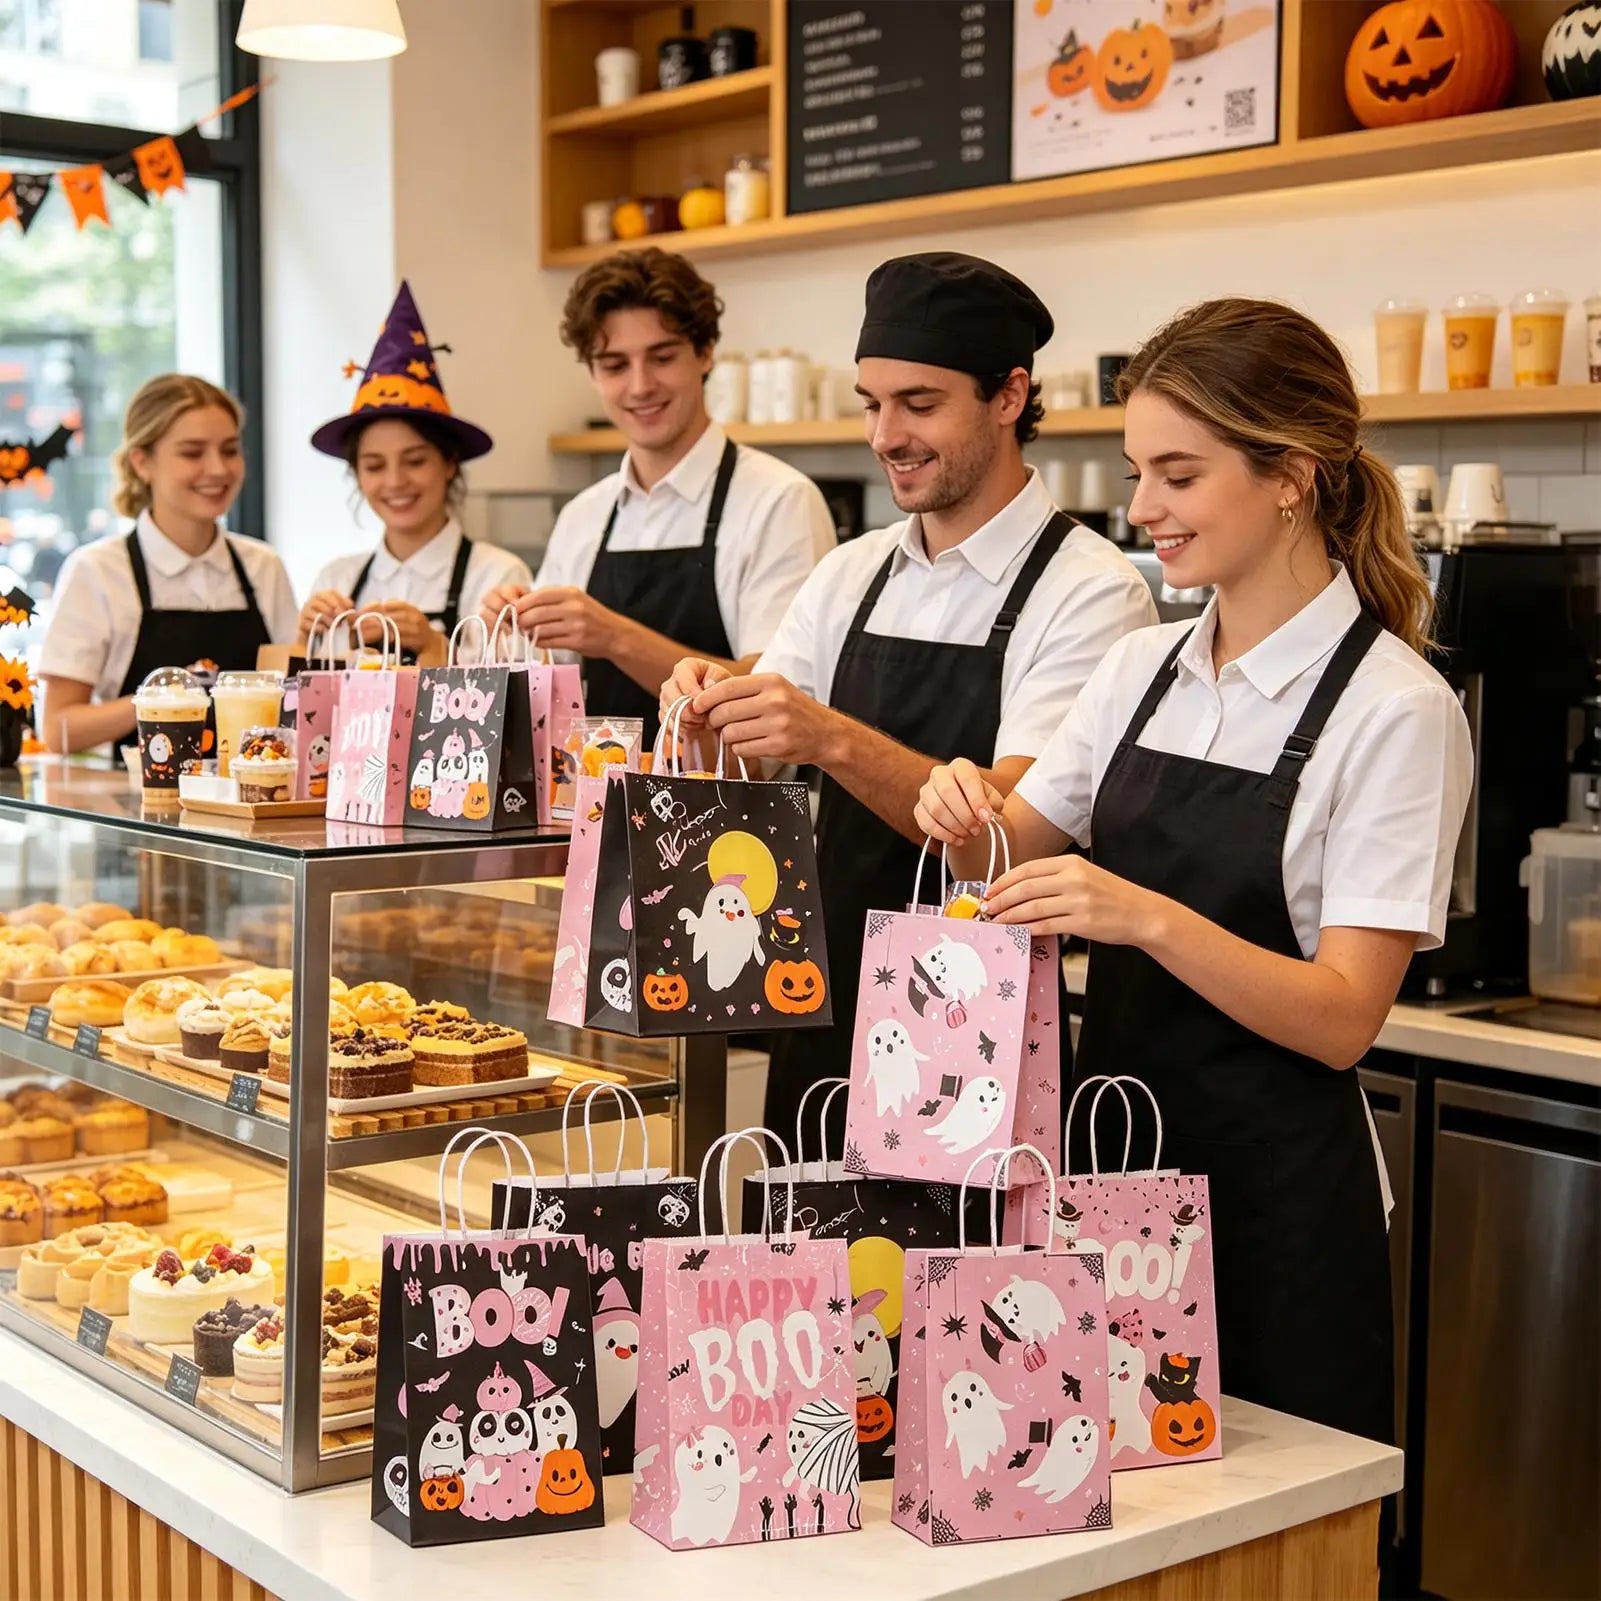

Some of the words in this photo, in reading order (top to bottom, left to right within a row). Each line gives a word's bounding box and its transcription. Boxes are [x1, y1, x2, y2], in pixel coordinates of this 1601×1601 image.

[428, 1284, 570, 1358] BOO!
[697, 1276, 818, 1324] HAPPY
[688, 1310, 824, 1412] BOO
[730, 1390, 793, 1427] DAY
